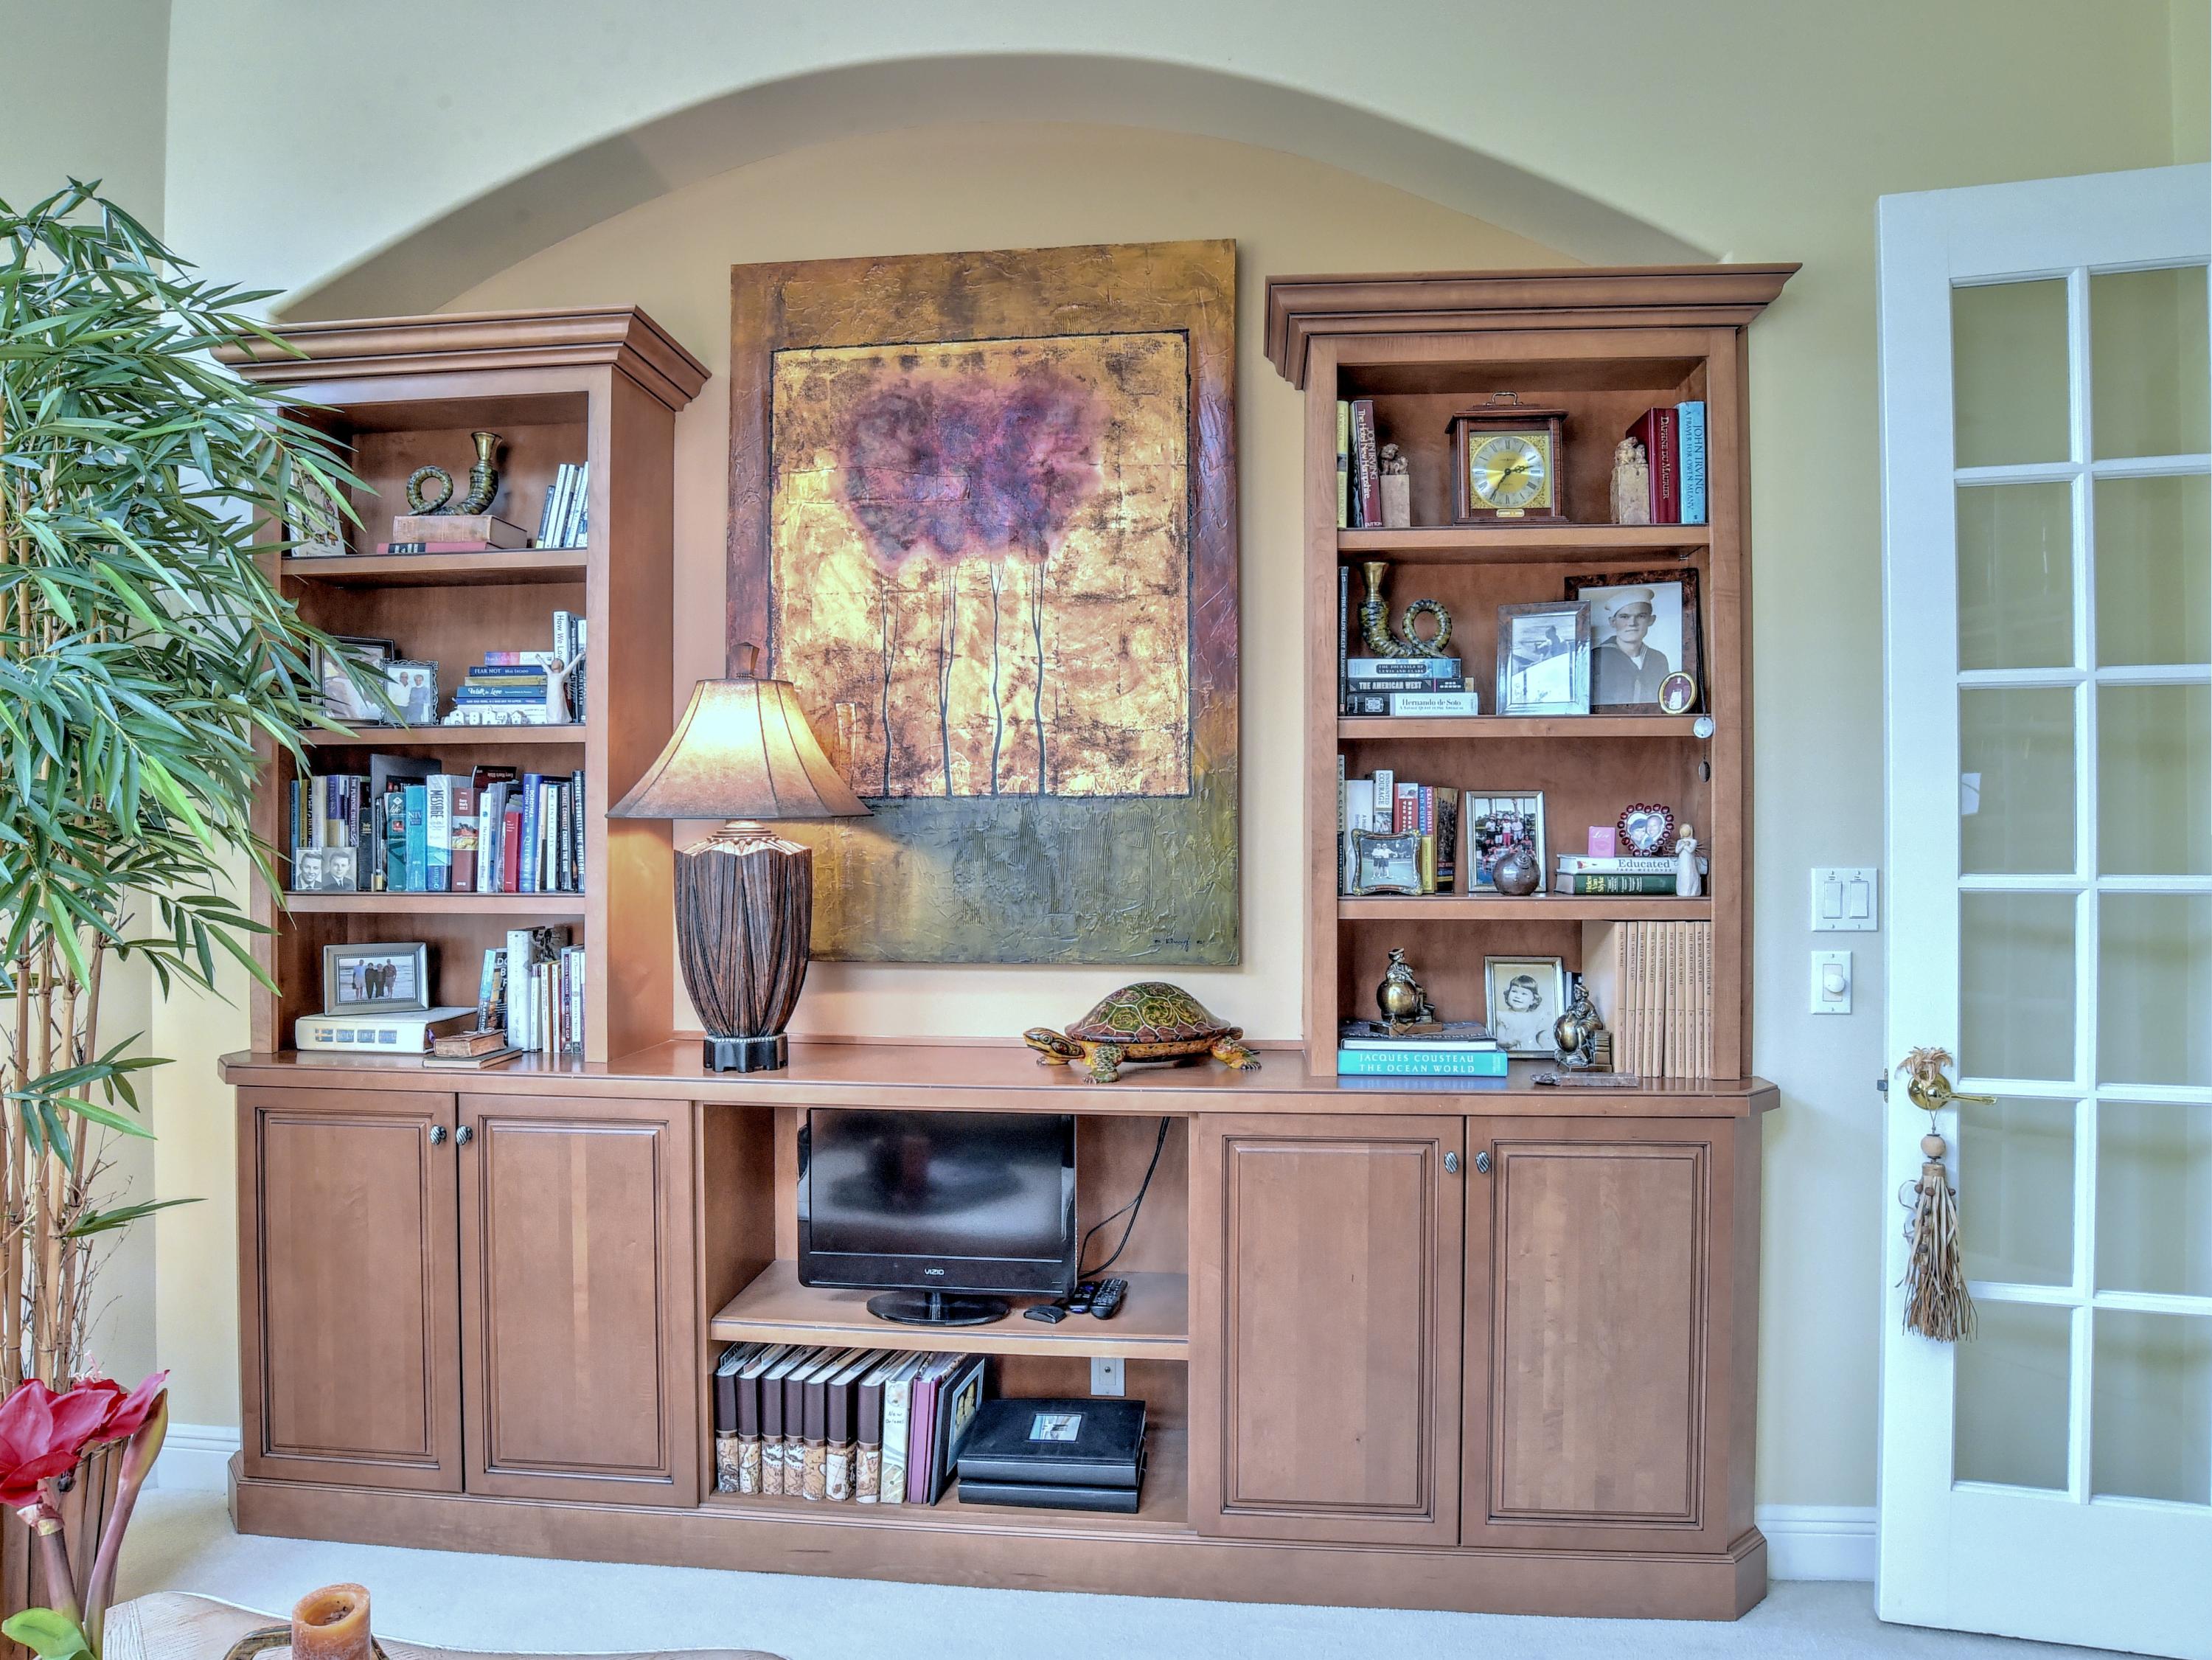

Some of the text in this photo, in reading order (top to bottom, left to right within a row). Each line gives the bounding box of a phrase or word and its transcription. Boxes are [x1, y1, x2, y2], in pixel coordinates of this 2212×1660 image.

[1357, 409, 1371, 499] The Hotel New Hampshire
[1367, 428, 1377, 480] JOHN IRVING
[1660, 416, 1671, 499] DAPHNE DU MAURIER
[1694, 425, 1704, 494] JOHN IRVING
[557, 633, 564, 644] We
[1372, 681, 1404, 690] AMERICAN
[430, 790, 444, 819] MESSAGE
[575, 802, 583, 830] CONNELLY
[1618, 858, 1670, 868] Educated
[480, 1001, 488, 1032] PLANTATIO
[1360, 1054, 1409, 1062] JACQUES
[1360, 1064, 1475, 1073] THE OCEAN WORLD
